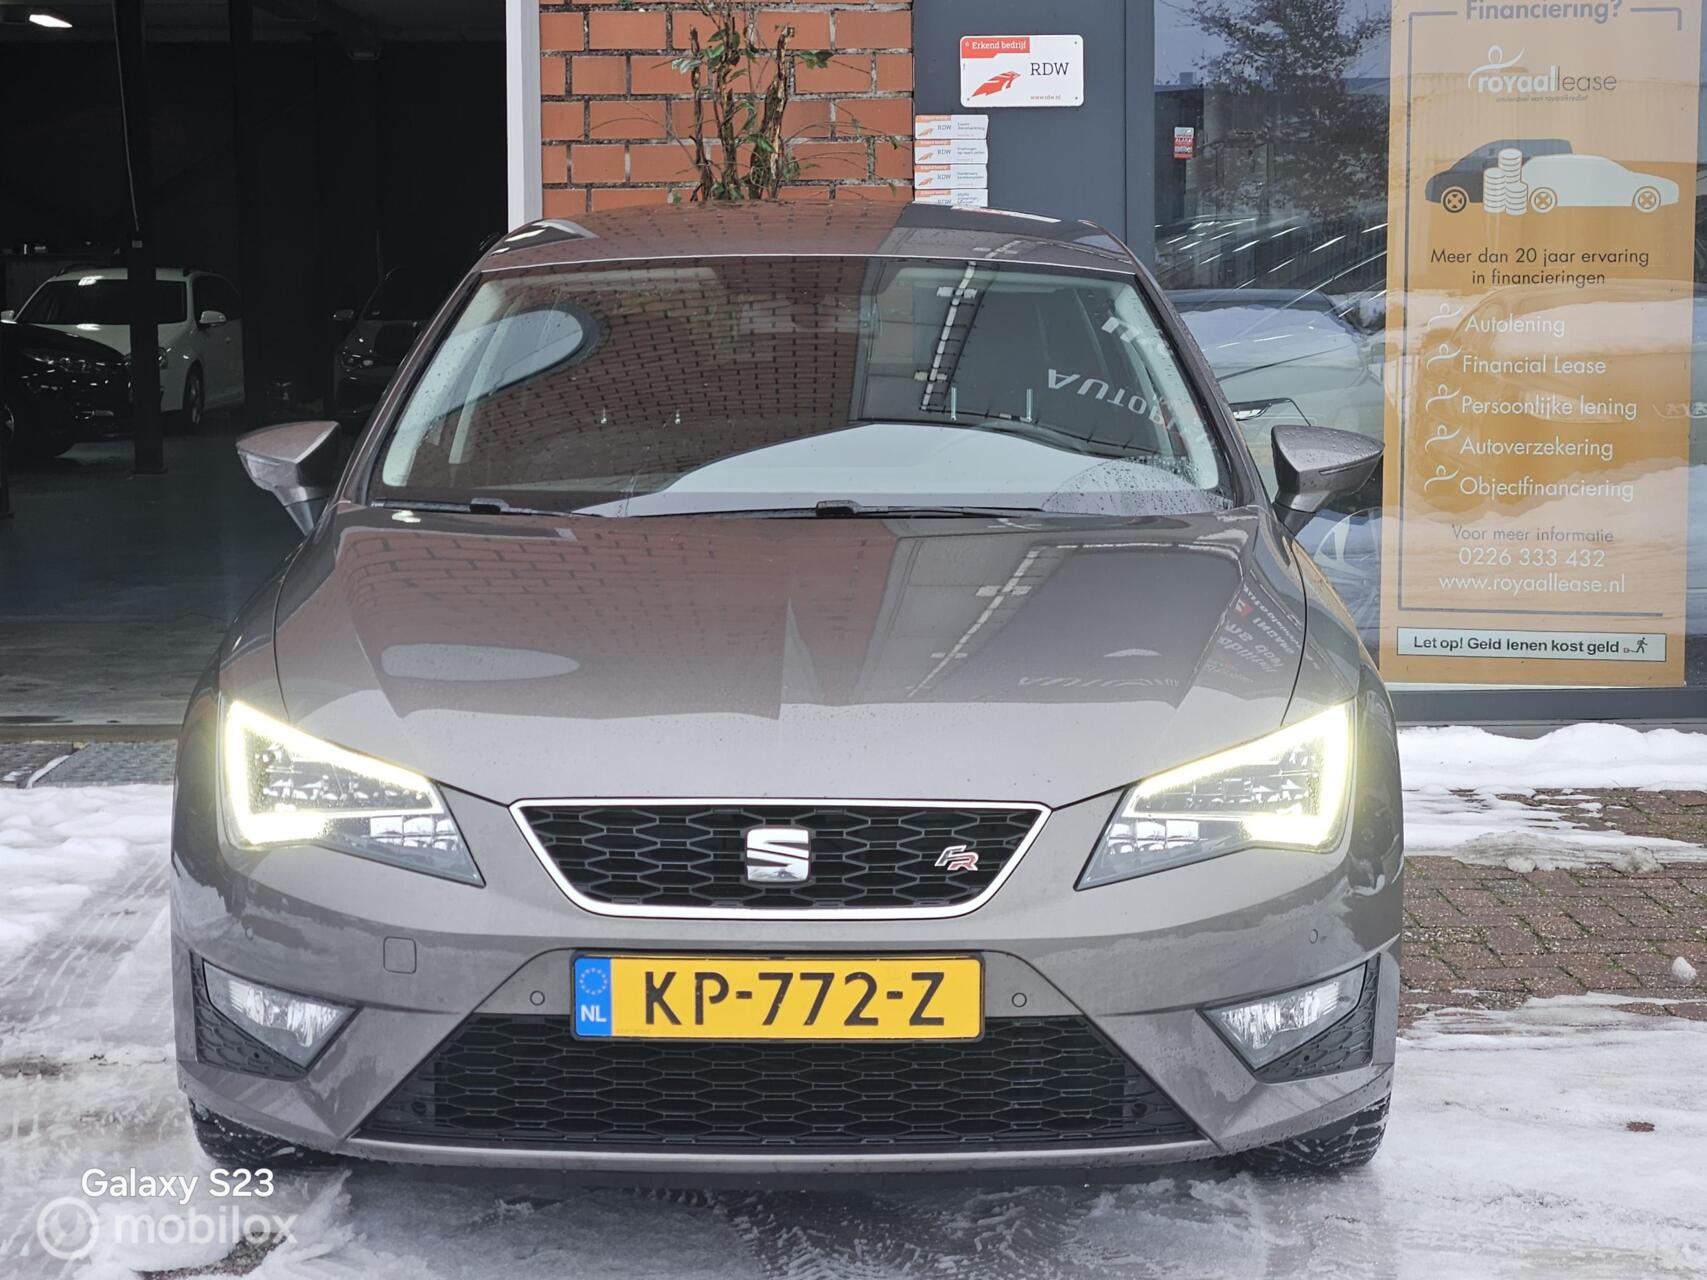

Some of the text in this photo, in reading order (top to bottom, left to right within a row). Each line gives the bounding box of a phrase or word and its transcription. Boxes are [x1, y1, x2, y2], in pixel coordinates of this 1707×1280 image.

[1466, 0, 1622, 24] Financiering?
[972, 40, 1026, 50] Erkend bedrijf
[1030, 62, 1069, 76] RDW
[1431, 248, 1649, 267] Meer dan 20 jaar ervaring
[1472, 269, 1605, 288] in financieringen
[1465, 315, 1565, 337] Autolening
[1462, 355, 1606, 374] Financial Lease
[1461, 396, 1637, 420] Persoonlijke lening
[1460, 436, 1613, 460] Autoverzekering
[1459, 477, 1634, 502] Objectfinanciering
[1452, 525, 1614, 543] Voor meer informatie
[1458, 547, 1605, 568] 0226 333 432
[1439, 573, 1625, 597] www.royaallease.nl
[1413, 636, 1619, 656] Let op! Geld lenen kost geld
[934, 844, 979, 871] FR
[580, 971, 945, 1026] NL KP-772-Z
